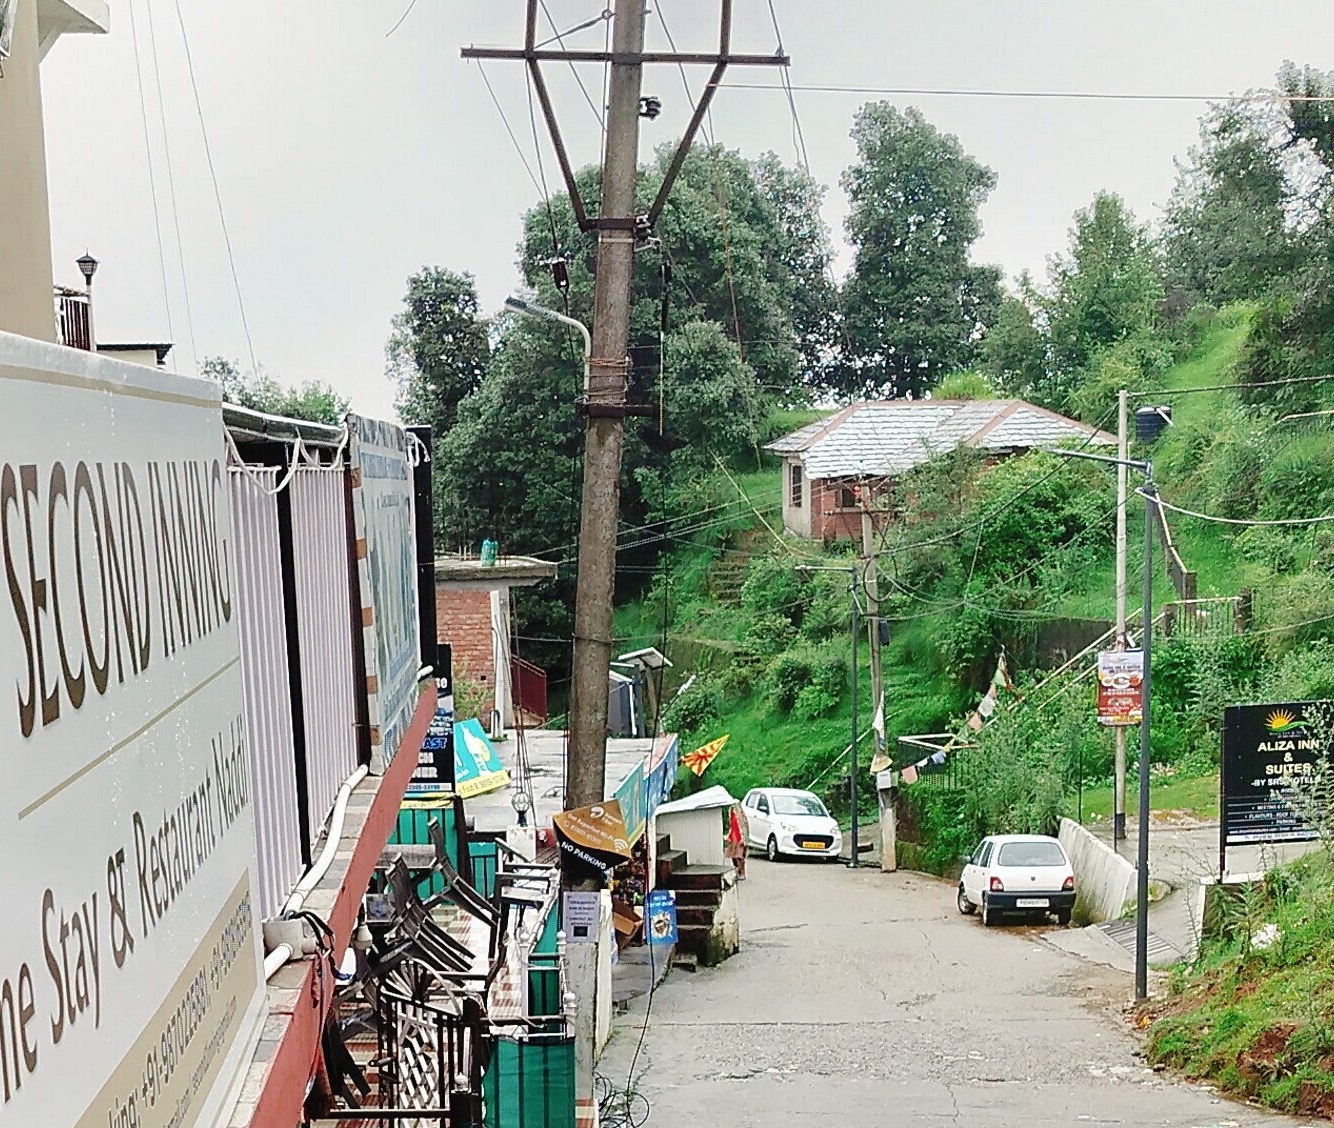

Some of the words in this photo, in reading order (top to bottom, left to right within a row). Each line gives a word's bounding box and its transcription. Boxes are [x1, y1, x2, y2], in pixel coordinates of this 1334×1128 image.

[0, 460, 151, 738] SECOND
[147, 458, 232, 657] INNING
[1257, 740, 1295, 752] ALIZA
[1297, 740, 1320, 750] INN
[1283, 752, 1293, 763] &
[1265, 763, 1312, 776] SUITES
[561, 841, 574, 852] NO
[573, 848, 607, 870] PARKING
[42, 888, 101, 1045] Stay
[107, 846, 134, 969] &
[132, 764, 216, 939] Restaurant
[211, 713, 249, 838] Naddi
